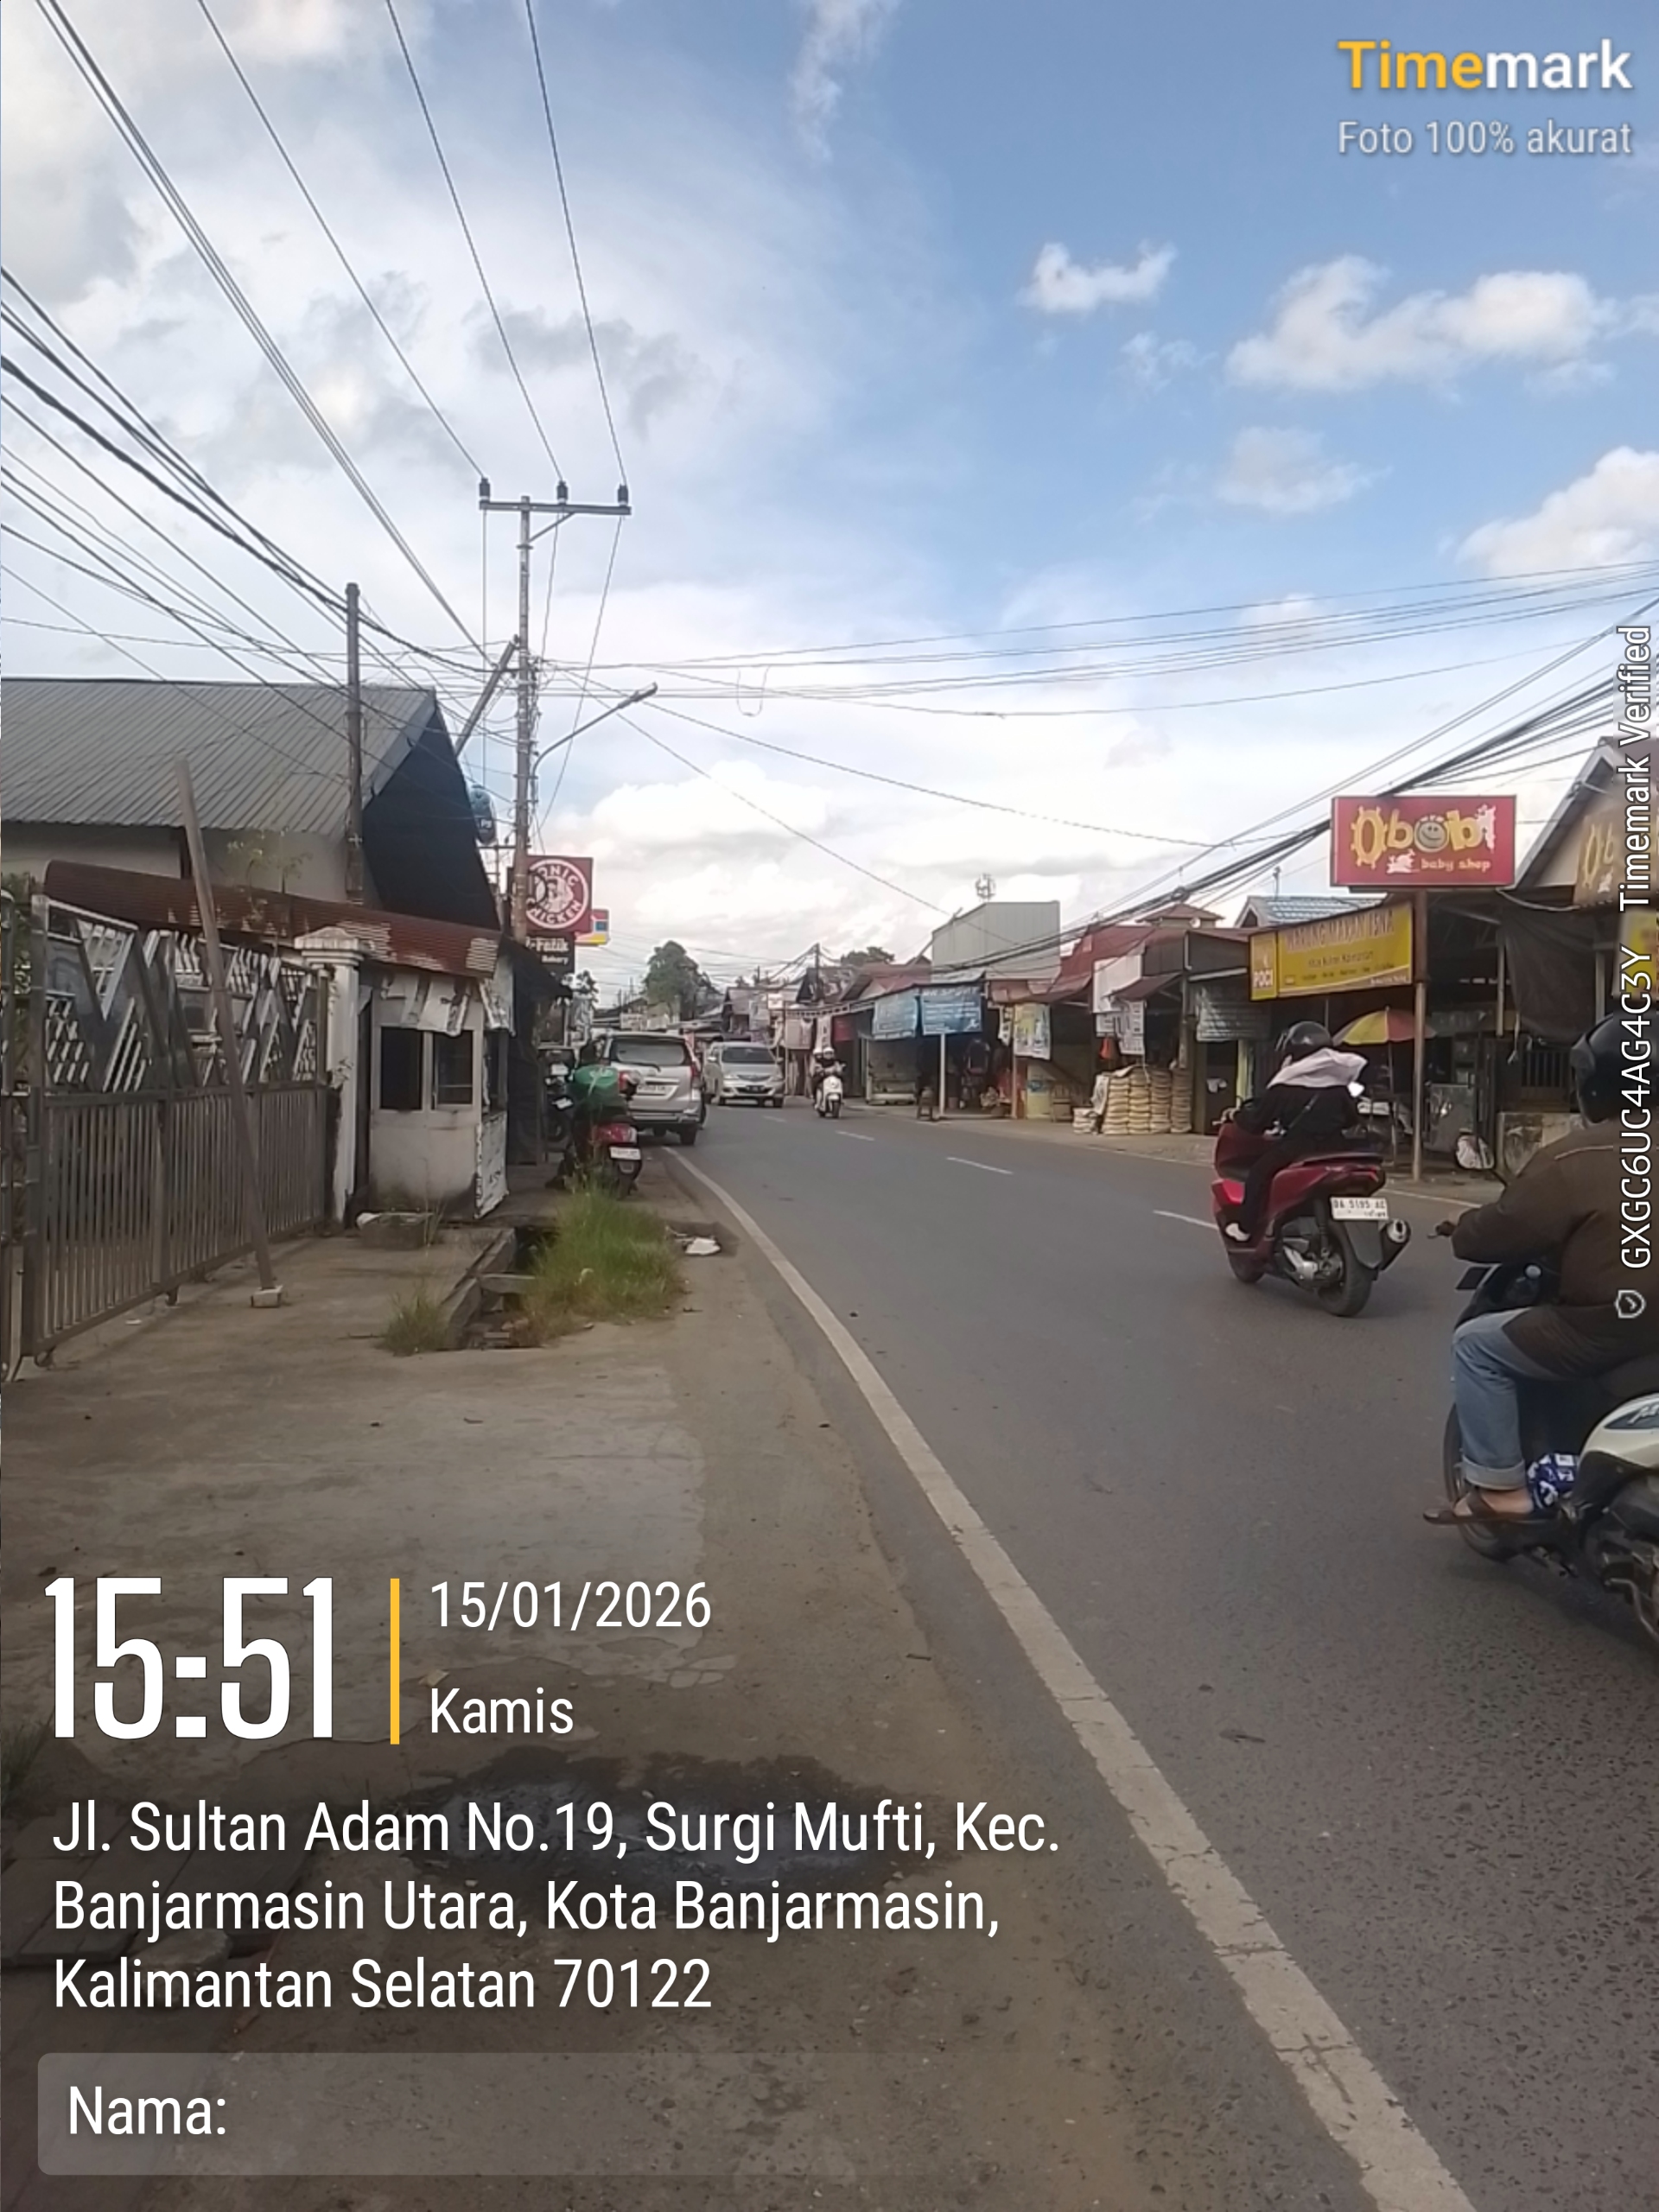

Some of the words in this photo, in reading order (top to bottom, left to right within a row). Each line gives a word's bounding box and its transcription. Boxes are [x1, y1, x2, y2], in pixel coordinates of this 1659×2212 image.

[1421, 858, 1453, 873] baby
[1459, 858, 1491, 873] shop
[534, 865, 580, 887] ONIC
